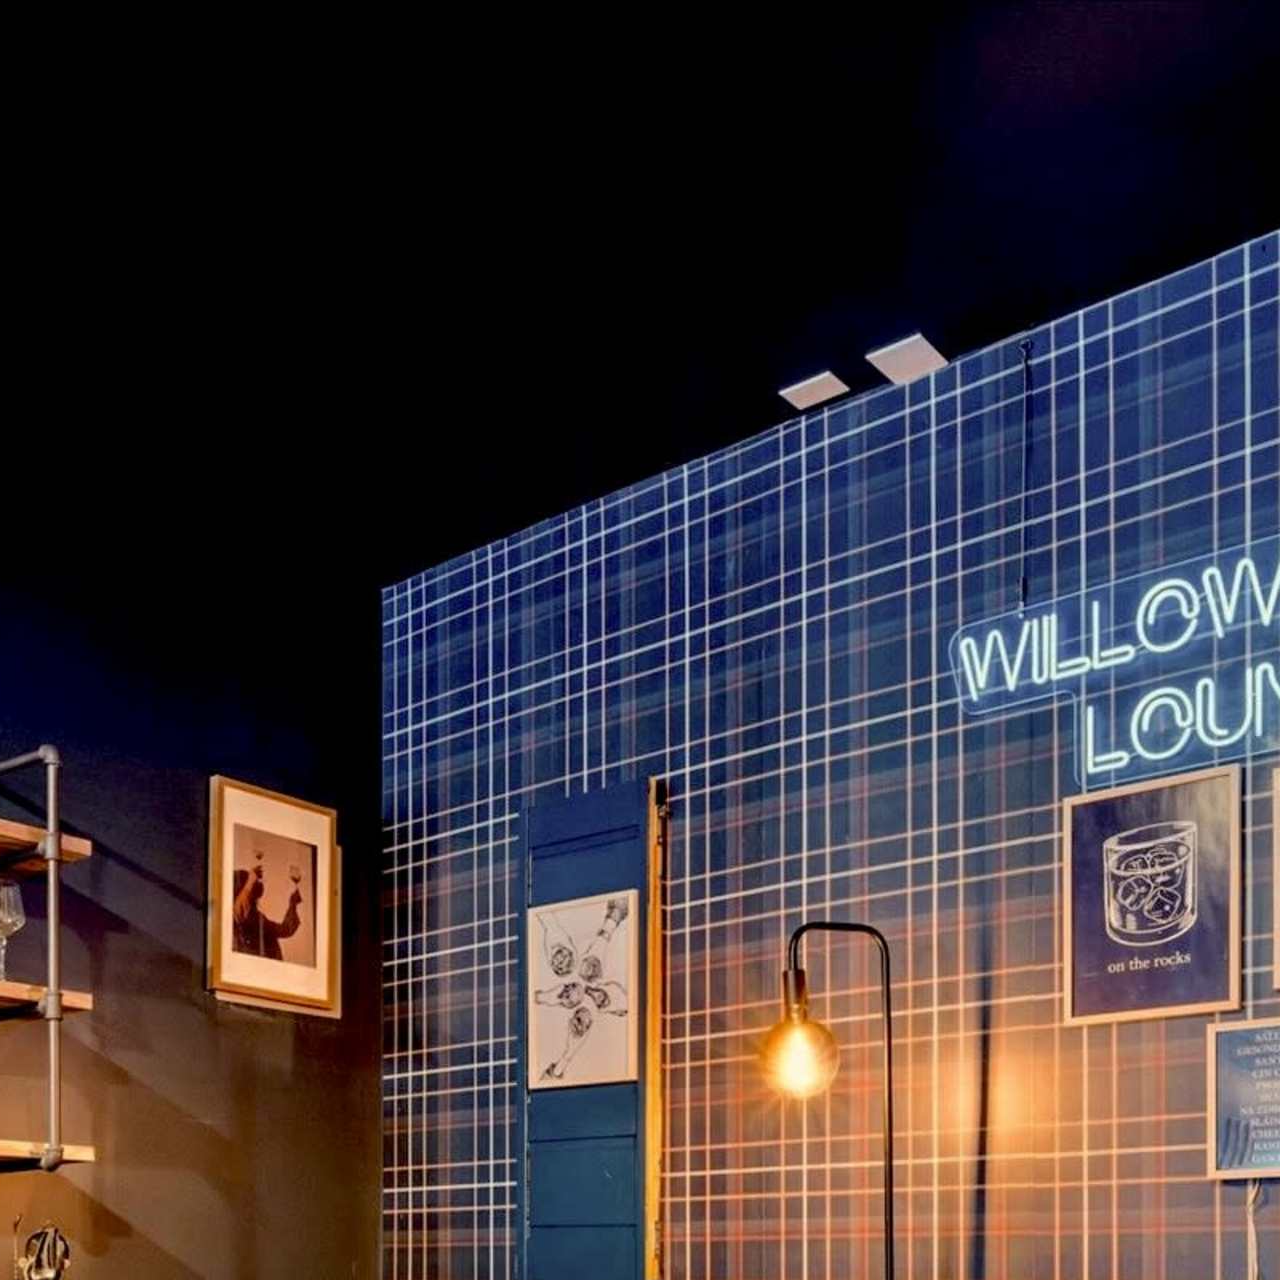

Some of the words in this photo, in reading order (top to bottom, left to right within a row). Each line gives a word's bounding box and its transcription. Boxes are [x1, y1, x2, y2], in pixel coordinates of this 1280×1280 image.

[1108, 963, 1125, 974] on
[1129, 956, 1150, 970] the
[1154, 950, 1191, 967] rocks
